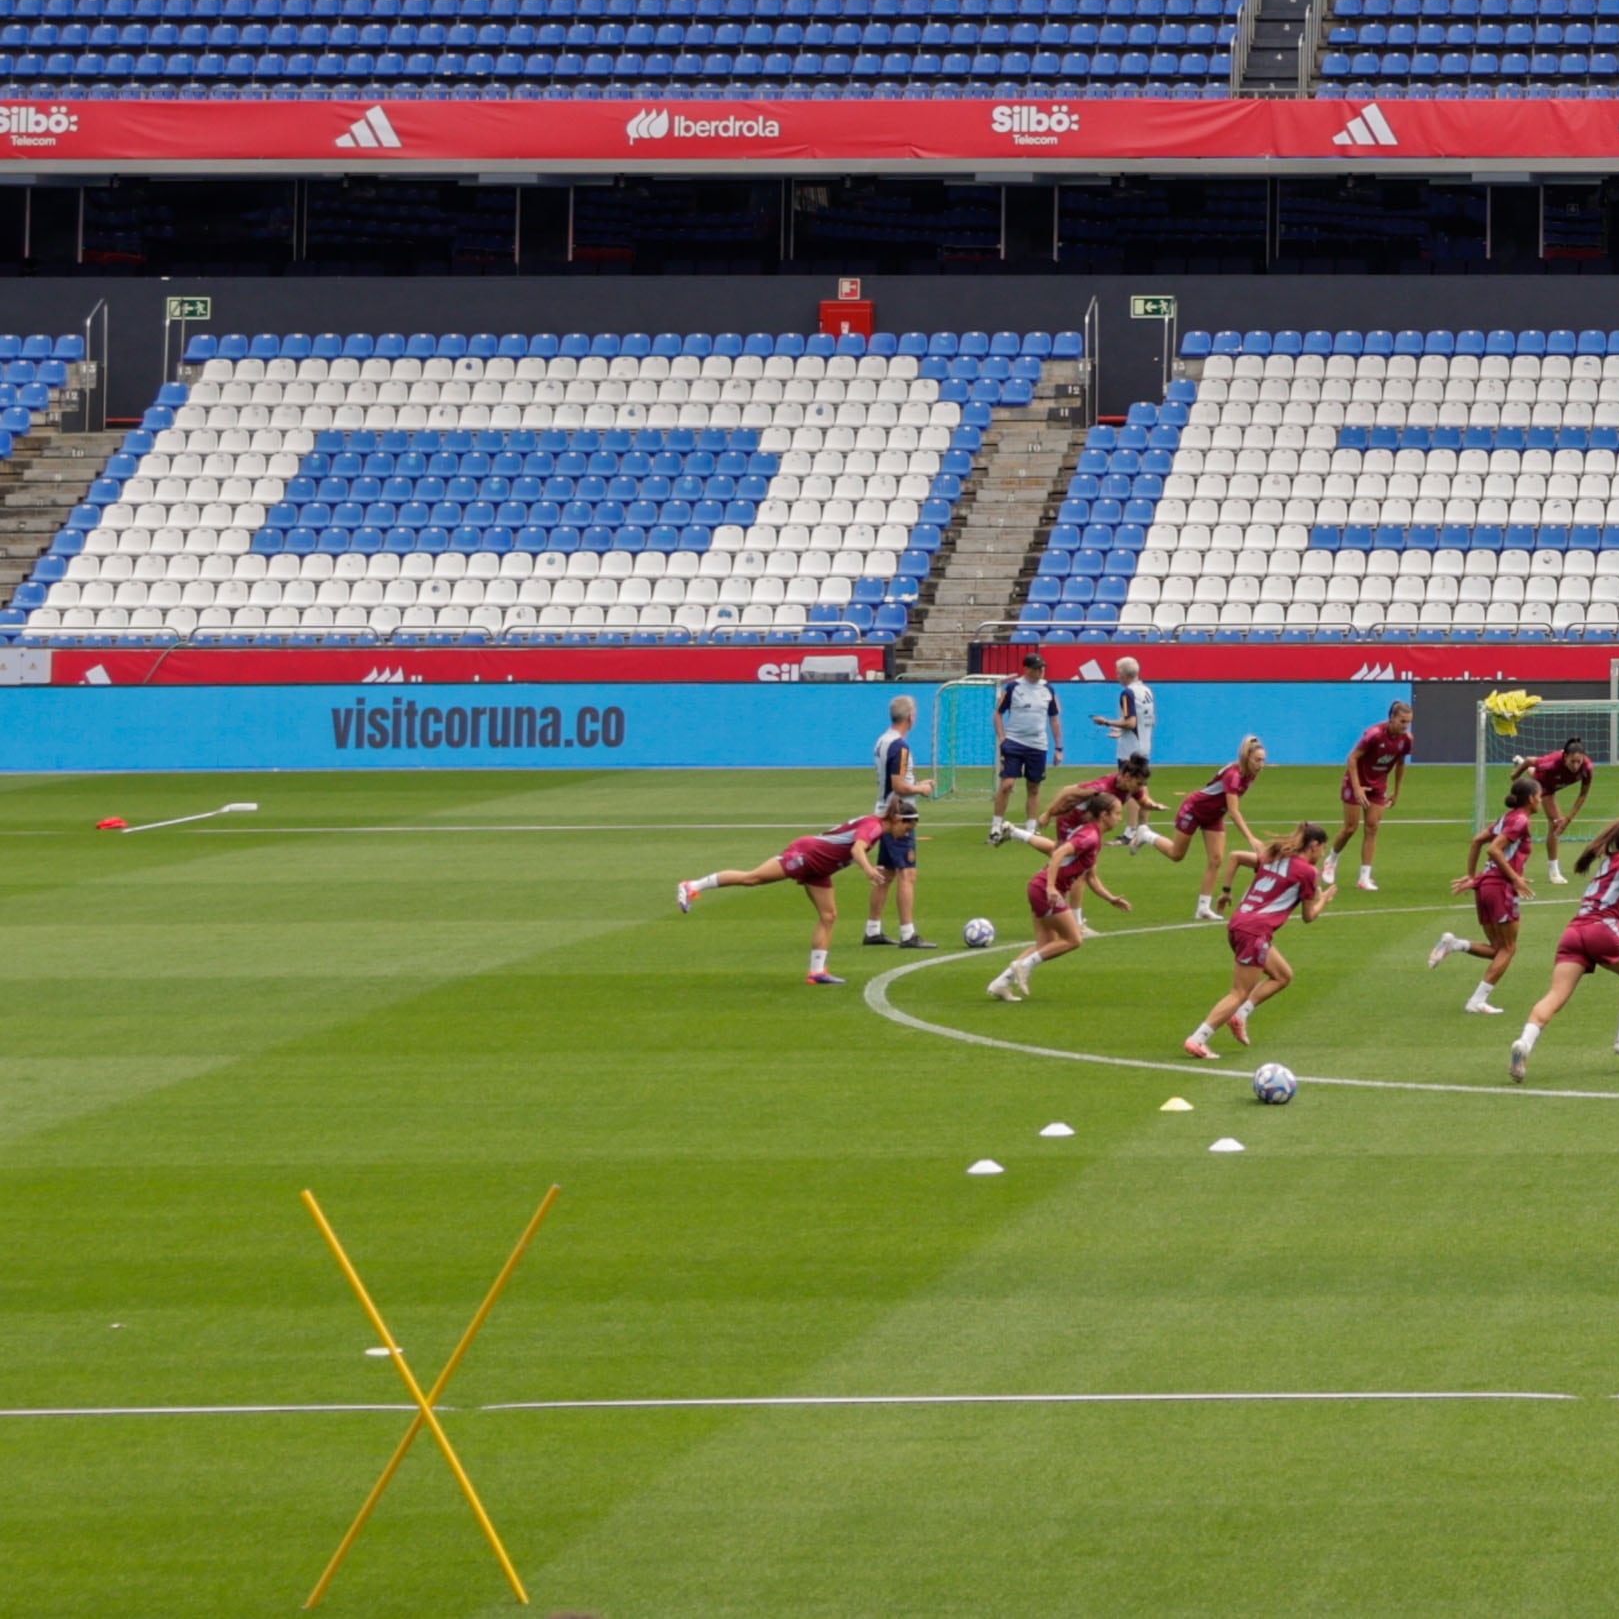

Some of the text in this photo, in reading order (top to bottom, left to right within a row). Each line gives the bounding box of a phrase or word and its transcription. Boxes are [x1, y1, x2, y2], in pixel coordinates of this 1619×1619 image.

[673, 115, 780, 138] Iberdrola
[10, 134, 56, 146] Telecom
[1012, 133, 1059, 145] Telecom
[332, 697, 625, 749] visitcoruna.co
